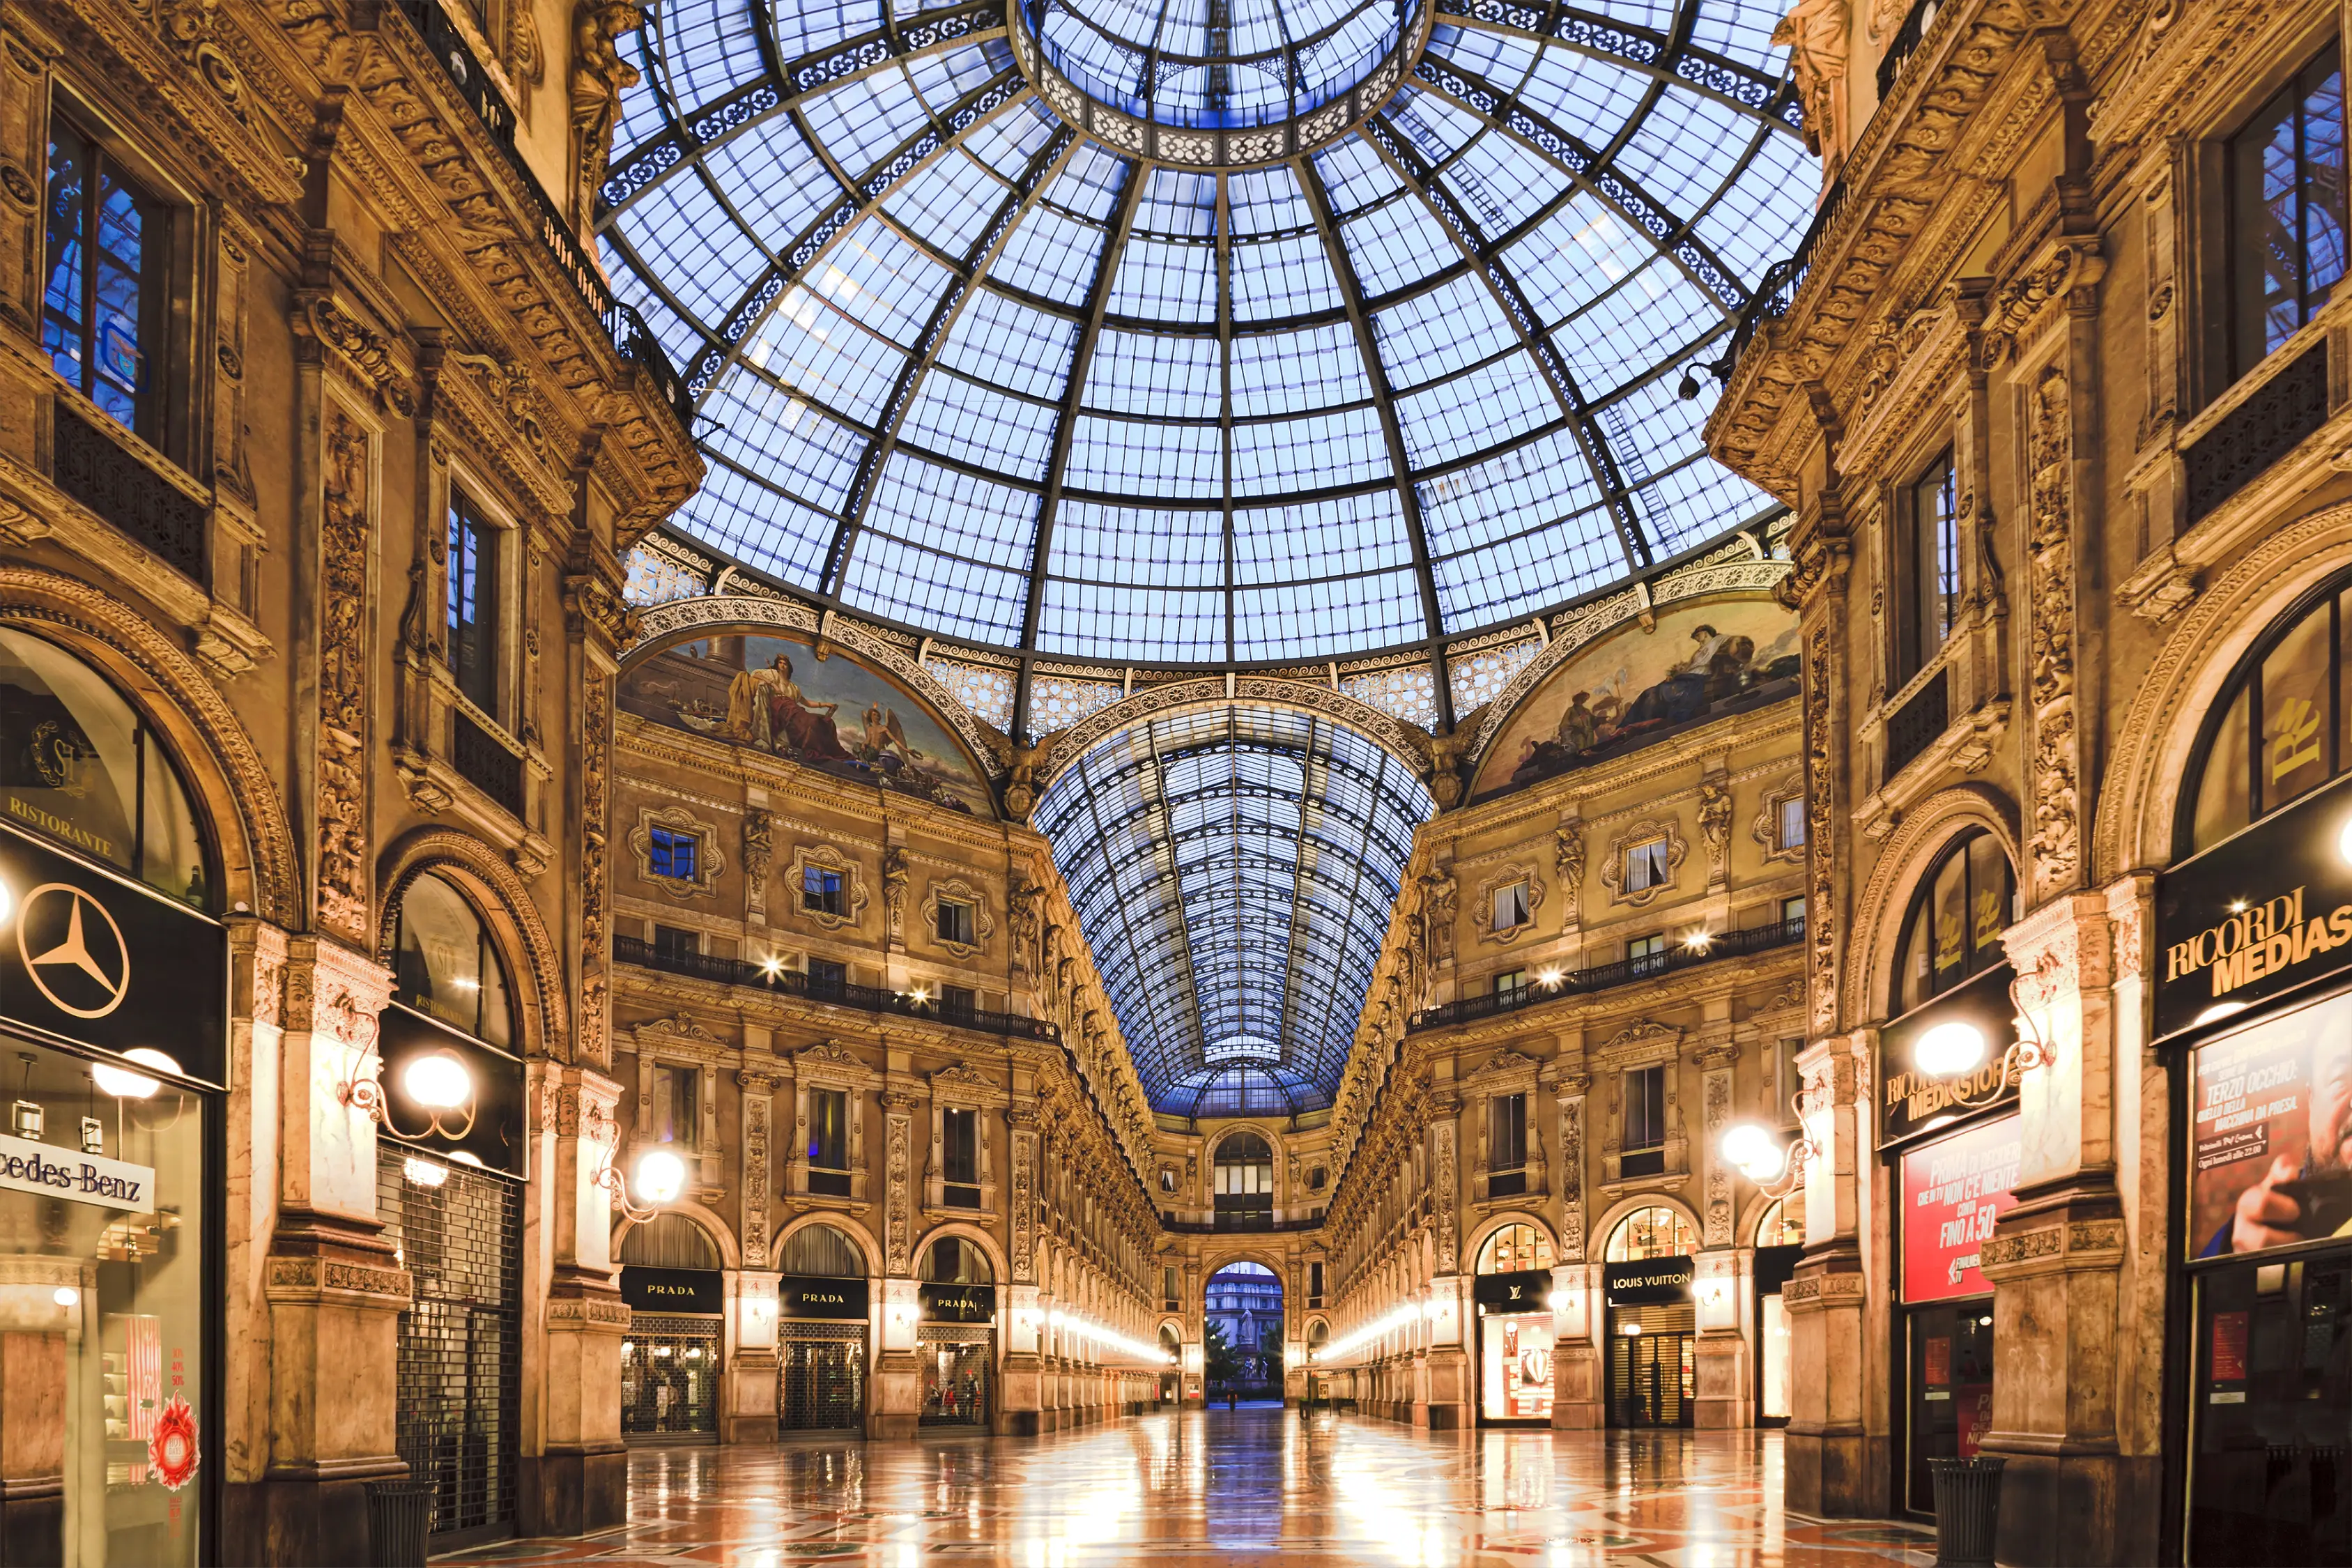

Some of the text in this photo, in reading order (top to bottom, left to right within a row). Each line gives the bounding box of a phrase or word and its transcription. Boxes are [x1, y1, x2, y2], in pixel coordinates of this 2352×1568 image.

[10, 796, 112, 857] RISTORANTE
[2165, 884, 2307, 983] RICORDI
[2212, 904, 2352, 998] MEDIAS
[1886, 1070, 1935, 1106] RICO
[2207, 1076, 2245, 1107] TERZO
[2197, 1096, 2246, 1123] QUELLO DELLA
[2214, 1108, 2254, 1133] MACCHINA
[2254, 1104, 2267, 1121] DA
[1929, 1148, 1967, 1187] PRIMA
[2198, 1157, 2213, 1169] Ogni
[2232, 1149, 2244, 1160] alle
[1917, 1190, 1930, 1207] CHE
[1929, 1187, 1937, 1204] IN
[1936, 1185, 1945, 1201] TV
[1943, 1179, 1965, 1207] NON
[1957, 1199, 1976, 1218] CONTA
[1939, 1204, 1996, 1249] FINO A 50
[647, 1284, 695, 1296] PRADA
[1613, 1273, 1691, 1289] LOUIS VUITTON
[802, 1293, 845, 1303] PRADA
[938, 1299, 974, 1308] PRADA
[171, 1361, 185, 1372] 40%
[171, 1374, 185, 1386] 50%
[169, 1438, 181, 1447] HOT
[1967, 1431, 1983, 1445] NO
